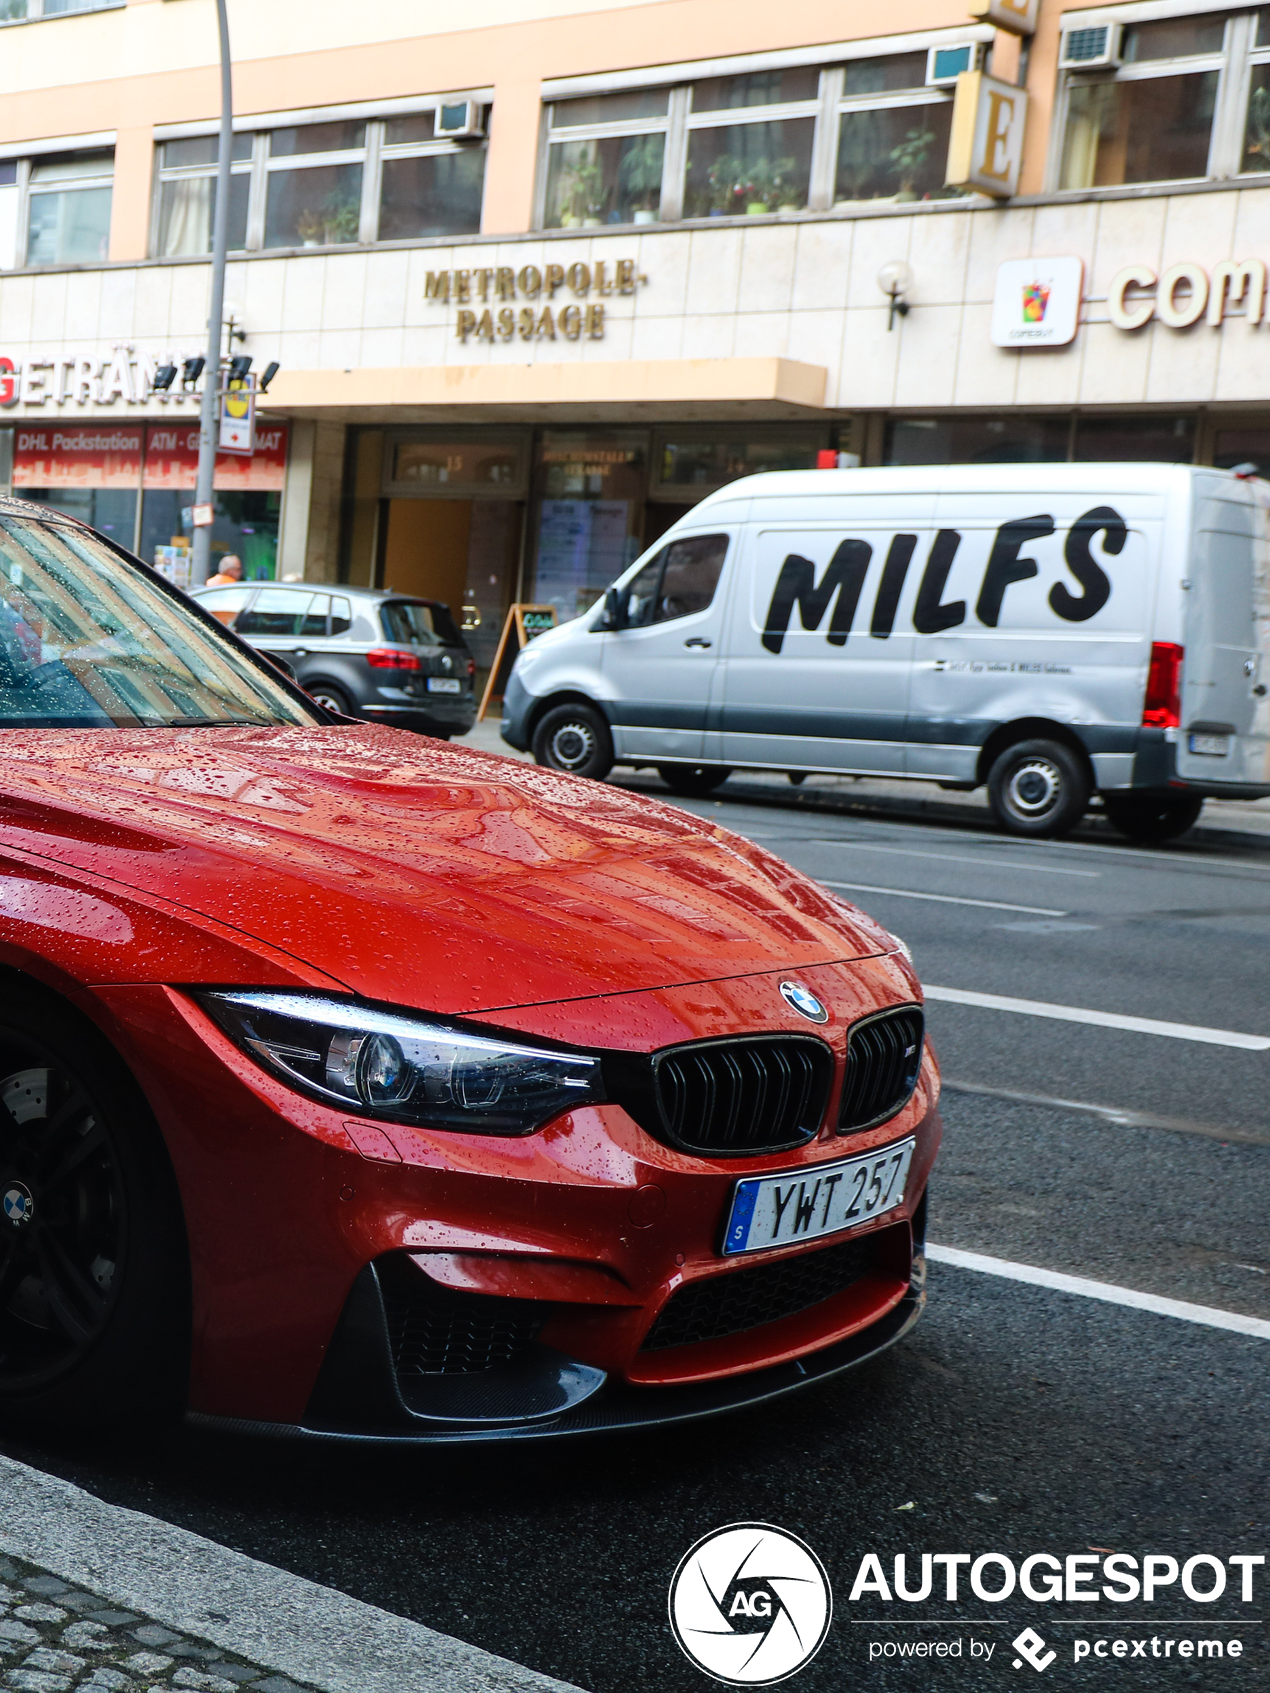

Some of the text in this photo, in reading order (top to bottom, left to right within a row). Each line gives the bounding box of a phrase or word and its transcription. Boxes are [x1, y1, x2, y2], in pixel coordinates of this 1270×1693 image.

[1109, 259, 1270, 330] COM
[455, 303, 607, 341] PASSAGE
[18, 433, 140, 451] DHL Packstation
[150, 432, 178, 450] ATM
[761, 506, 1128, 654] MILFS
[771, 1150, 905, 1238] YWT 257
[733, 1225, 744, 1240] S
